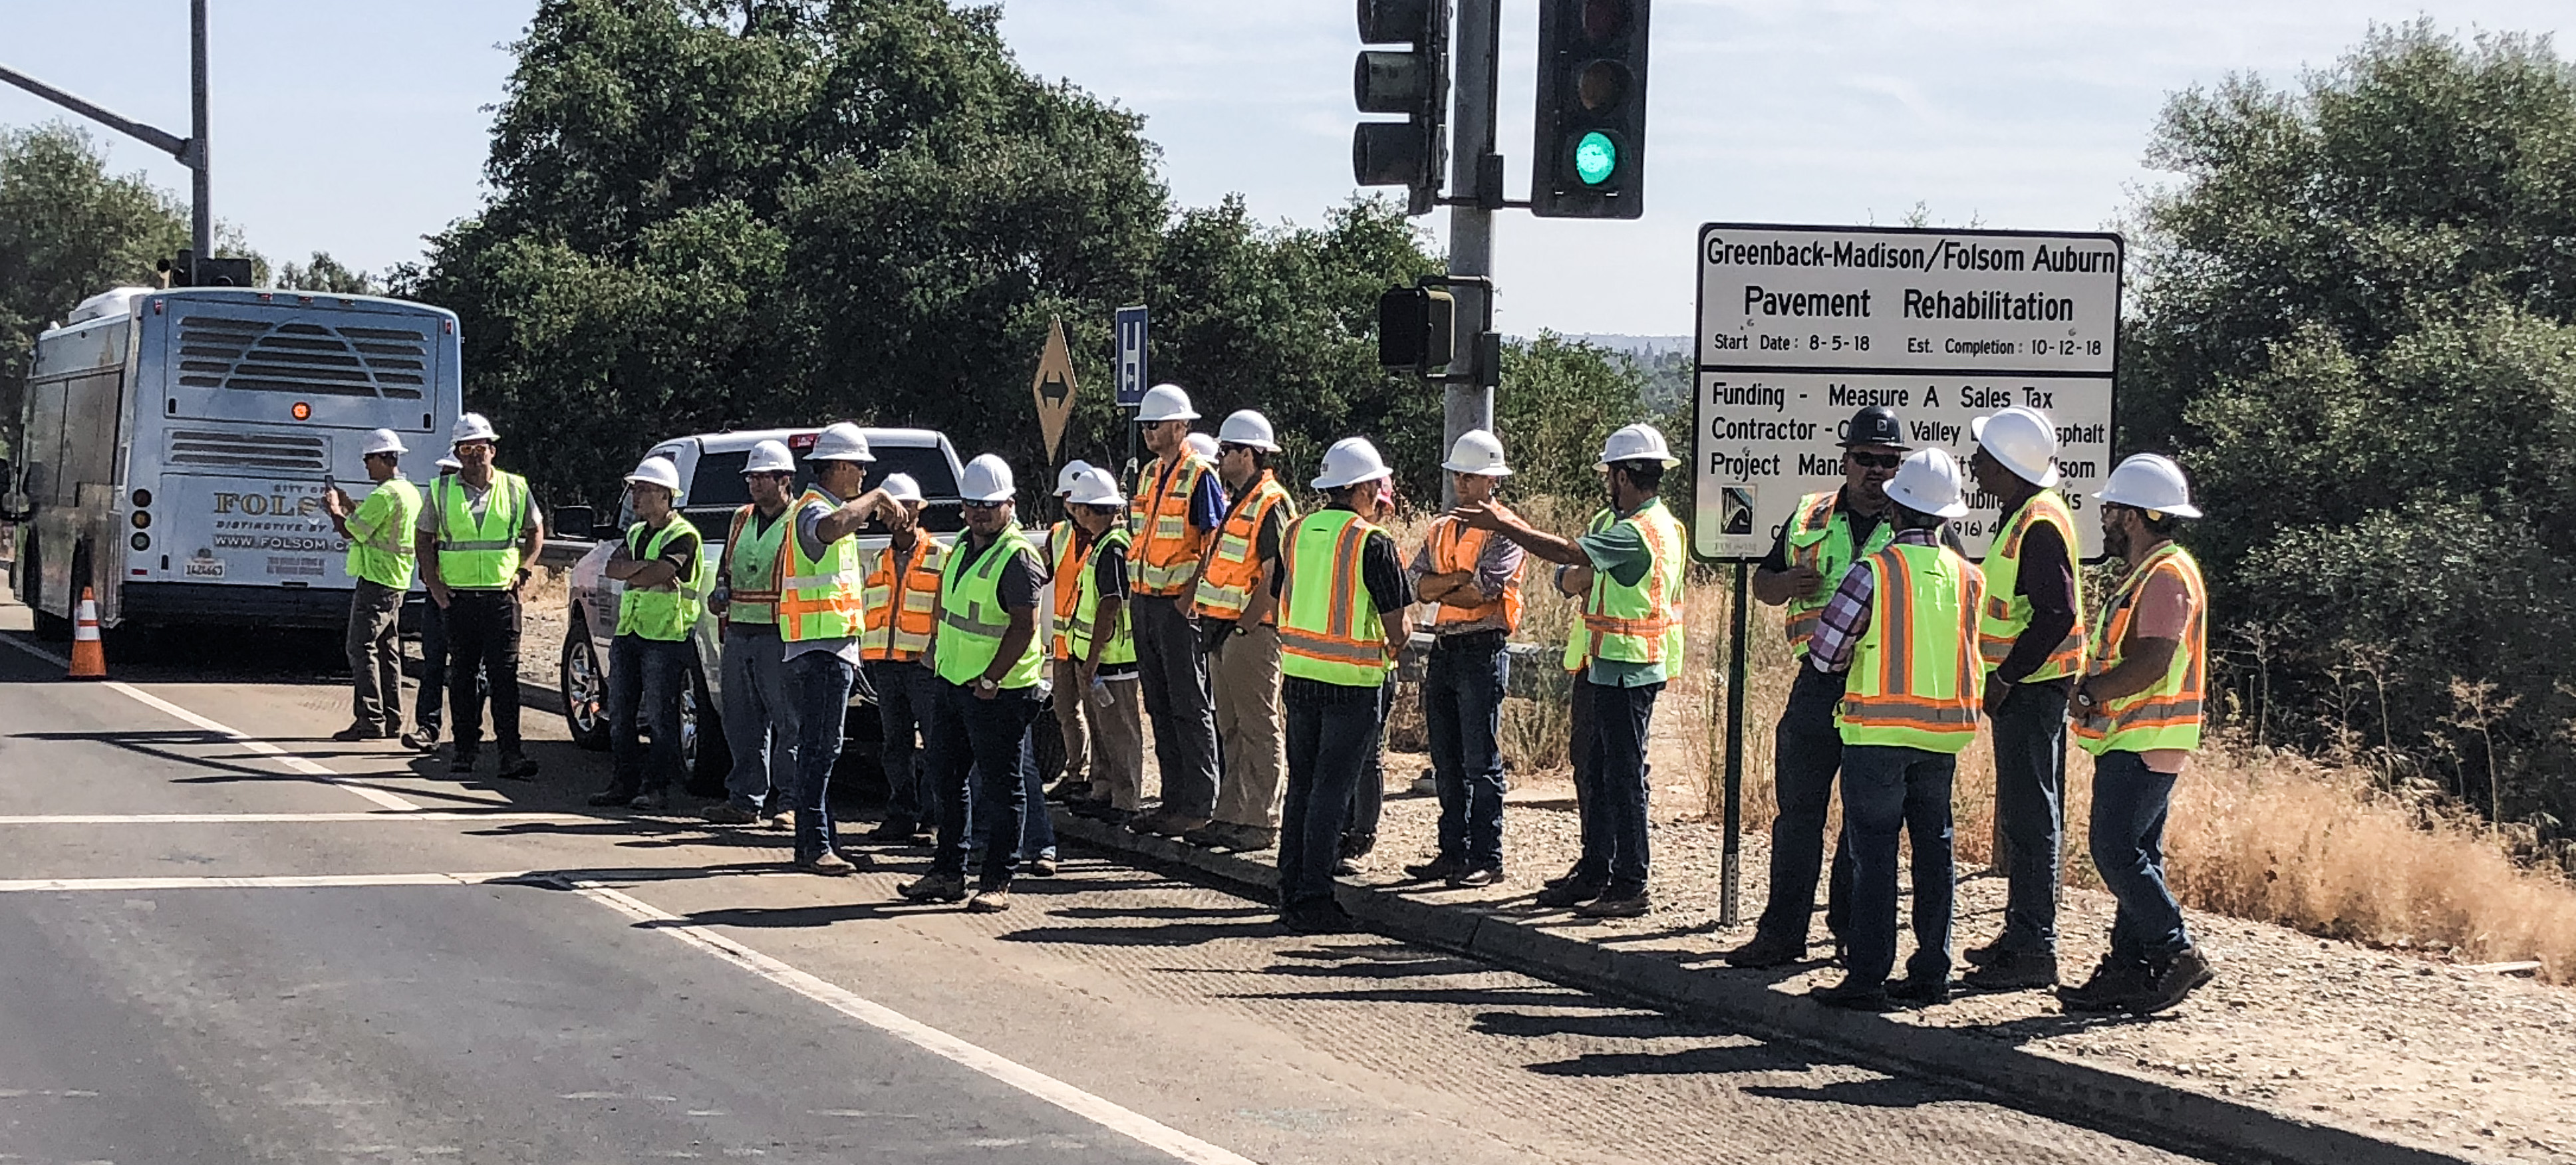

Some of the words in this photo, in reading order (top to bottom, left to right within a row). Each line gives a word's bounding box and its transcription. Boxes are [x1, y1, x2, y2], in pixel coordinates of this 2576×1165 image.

[1707, 237, 2024, 272] Greenback-Madison/Folsom
[2032, 245, 2115, 273] Auburn
[1745, 286, 1871, 317] Pavement
[1904, 289, 2073, 321] Rehabilitation
[1122, 321, 1140, 391] H
[1715, 334, 1749, 350] Start
[1908, 338, 1933, 354] Est.
[1713, 382, 1785, 412] Funding
[1830, 384, 1909, 406] Measure
[1923, 386, 1939, 408] A
[1961, 386, 2011, 408] Sales
[2022, 387, 2053, 409] Tax
[1712, 417, 1817, 440] Contractor
[1910, 421, 1961, 446] Valley
[2055, 424, 2104, 447] sphalt
[1711, 453, 1781, 482] Project
[1798, 453, 1848, 475] Mana
[1953, 520, 1981, 537] 916)
